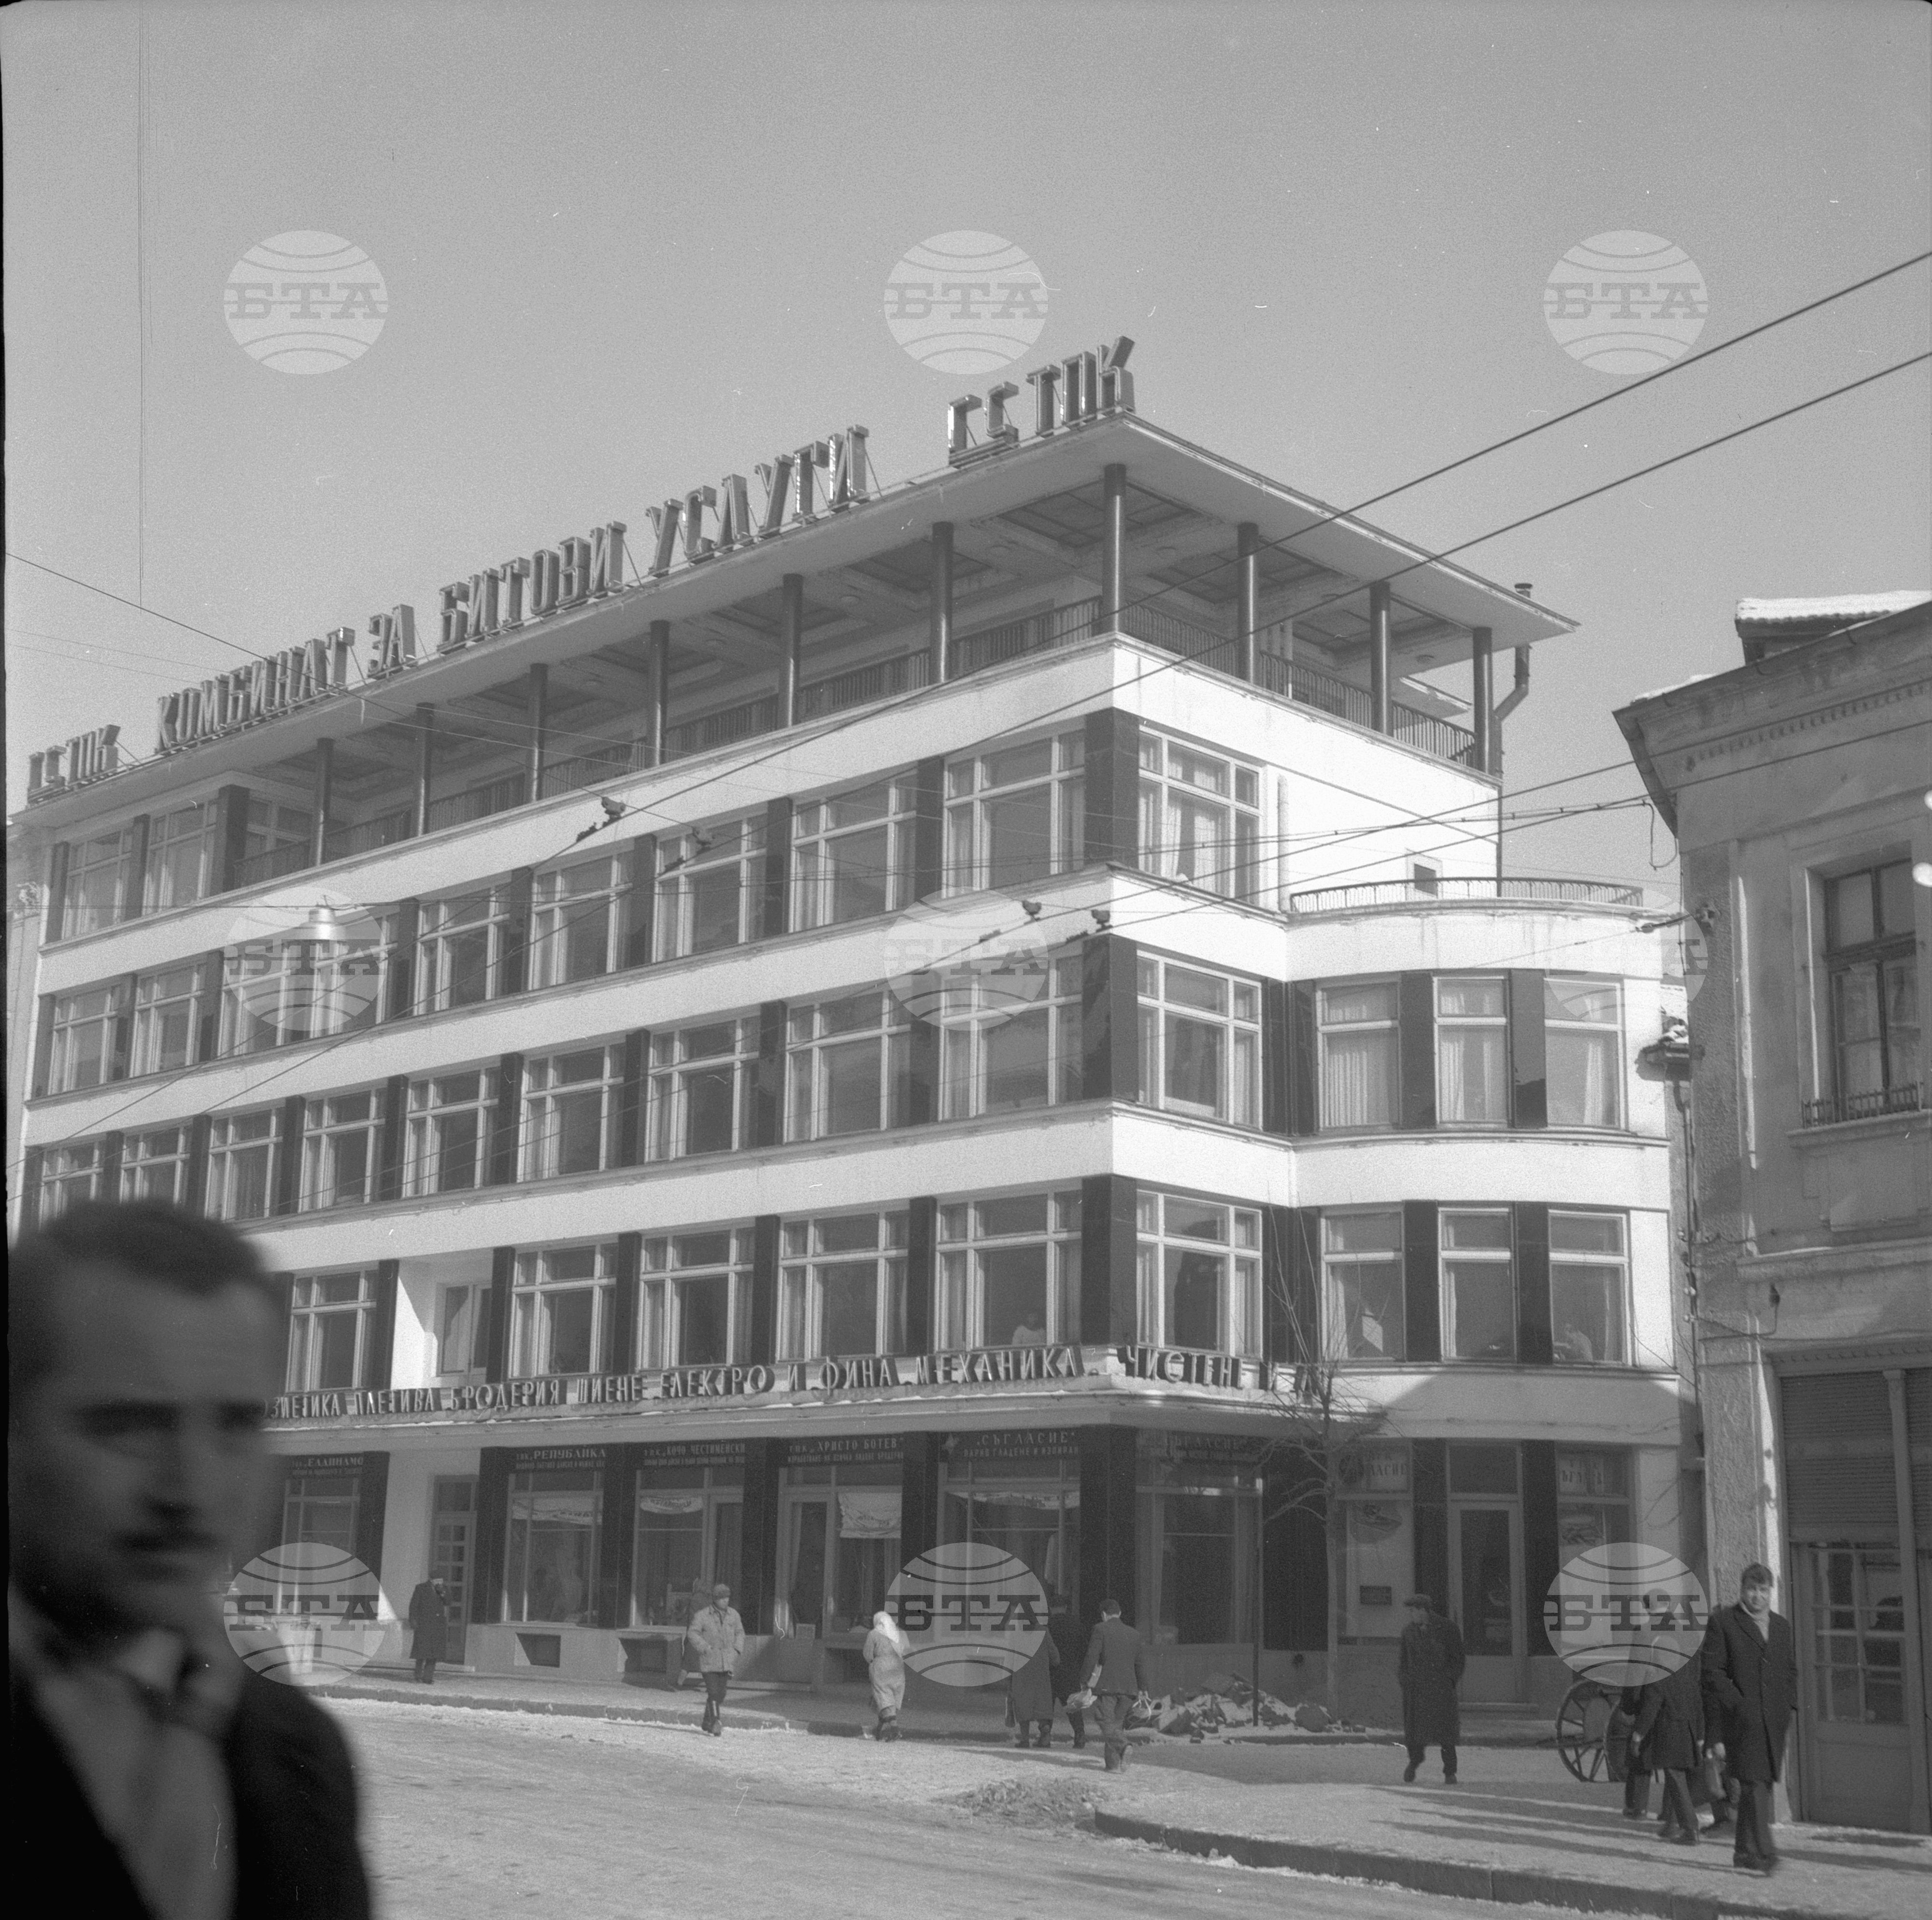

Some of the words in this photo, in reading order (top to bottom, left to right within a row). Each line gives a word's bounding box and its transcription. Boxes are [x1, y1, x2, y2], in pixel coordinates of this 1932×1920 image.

[155, 627, 355, 753] КОМБИНАТ
[369, 604, 416, 678] ЗА
[437, 521, 627, 654] БИТОВИ
[646, 424, 869, 578] УСЛУГИ
[354, 1388, 439, 1415] ПЛЕТИВА
[451, 1379, 563, 1411] БРОДЕРИЯ
[577, 1374, 643, 1404] ШИЕНЕ
[661, 1365, 772, 1398] ЕЛЕКТРО
[788, 1363, 805, 1391] И
[819, 1356, 897, 1396] ФИНА
[916, 1348, 1084, 1384] МЕХАНИКА
